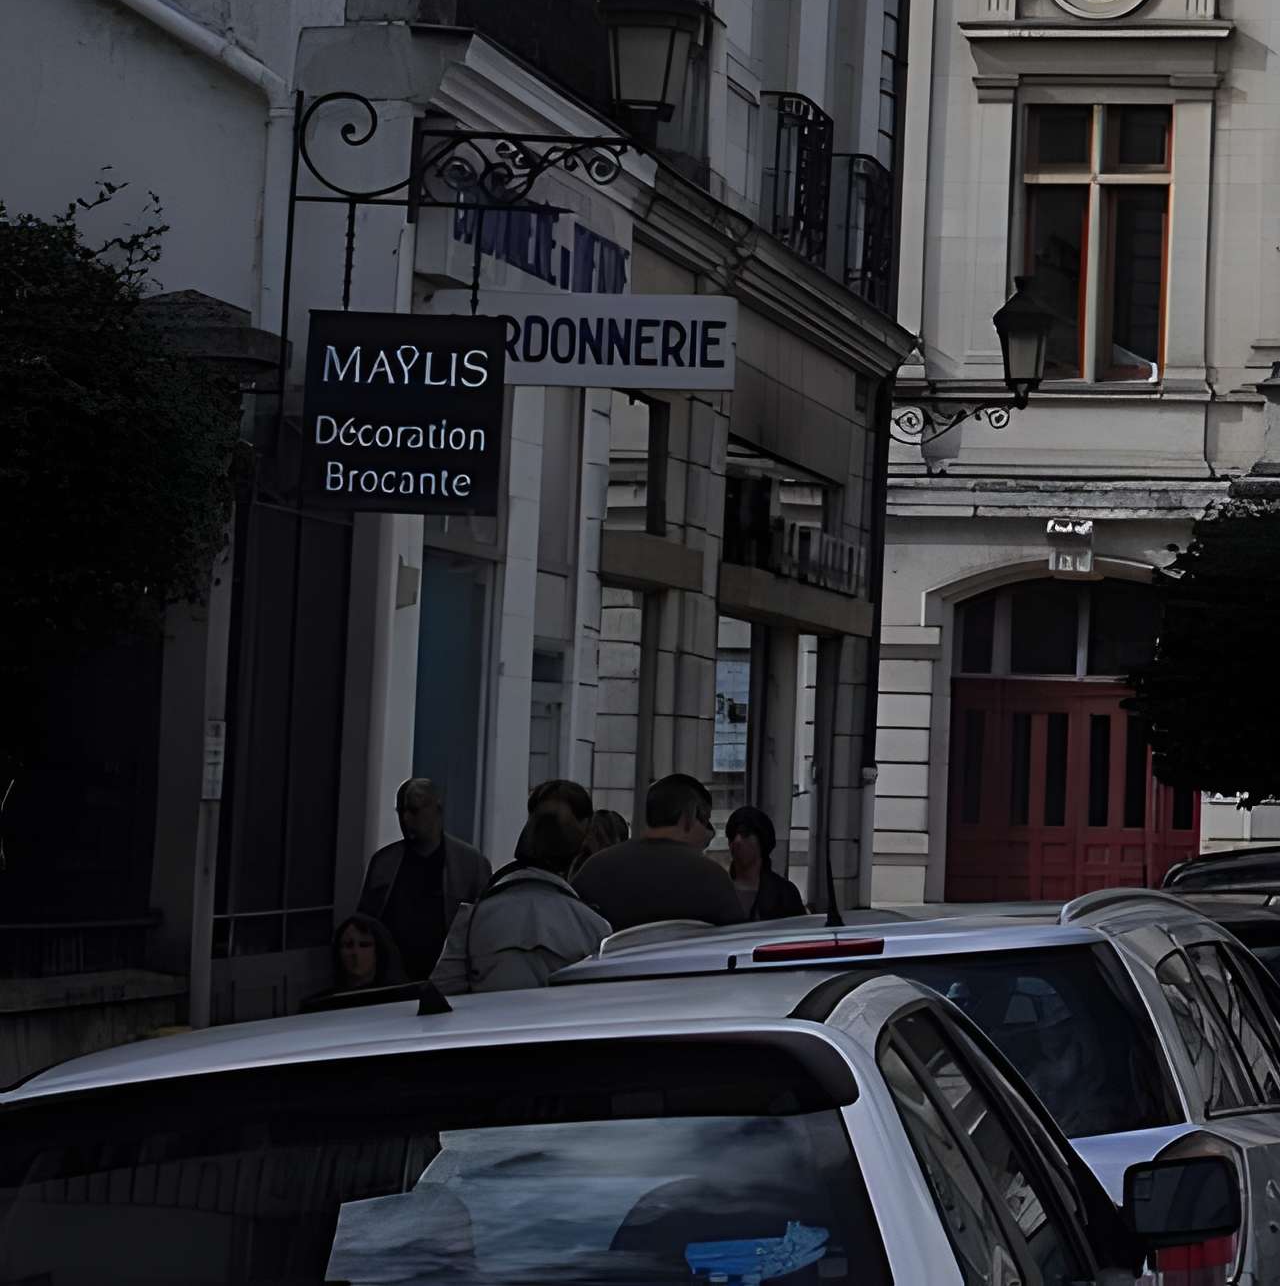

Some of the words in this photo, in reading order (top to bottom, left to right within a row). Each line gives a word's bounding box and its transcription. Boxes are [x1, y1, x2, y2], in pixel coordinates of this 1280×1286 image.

[321, 344, 490, 388] MAYLIS
[314, 414, 487, 452] Décoration
[324, 460, 472, 497] Brocante
